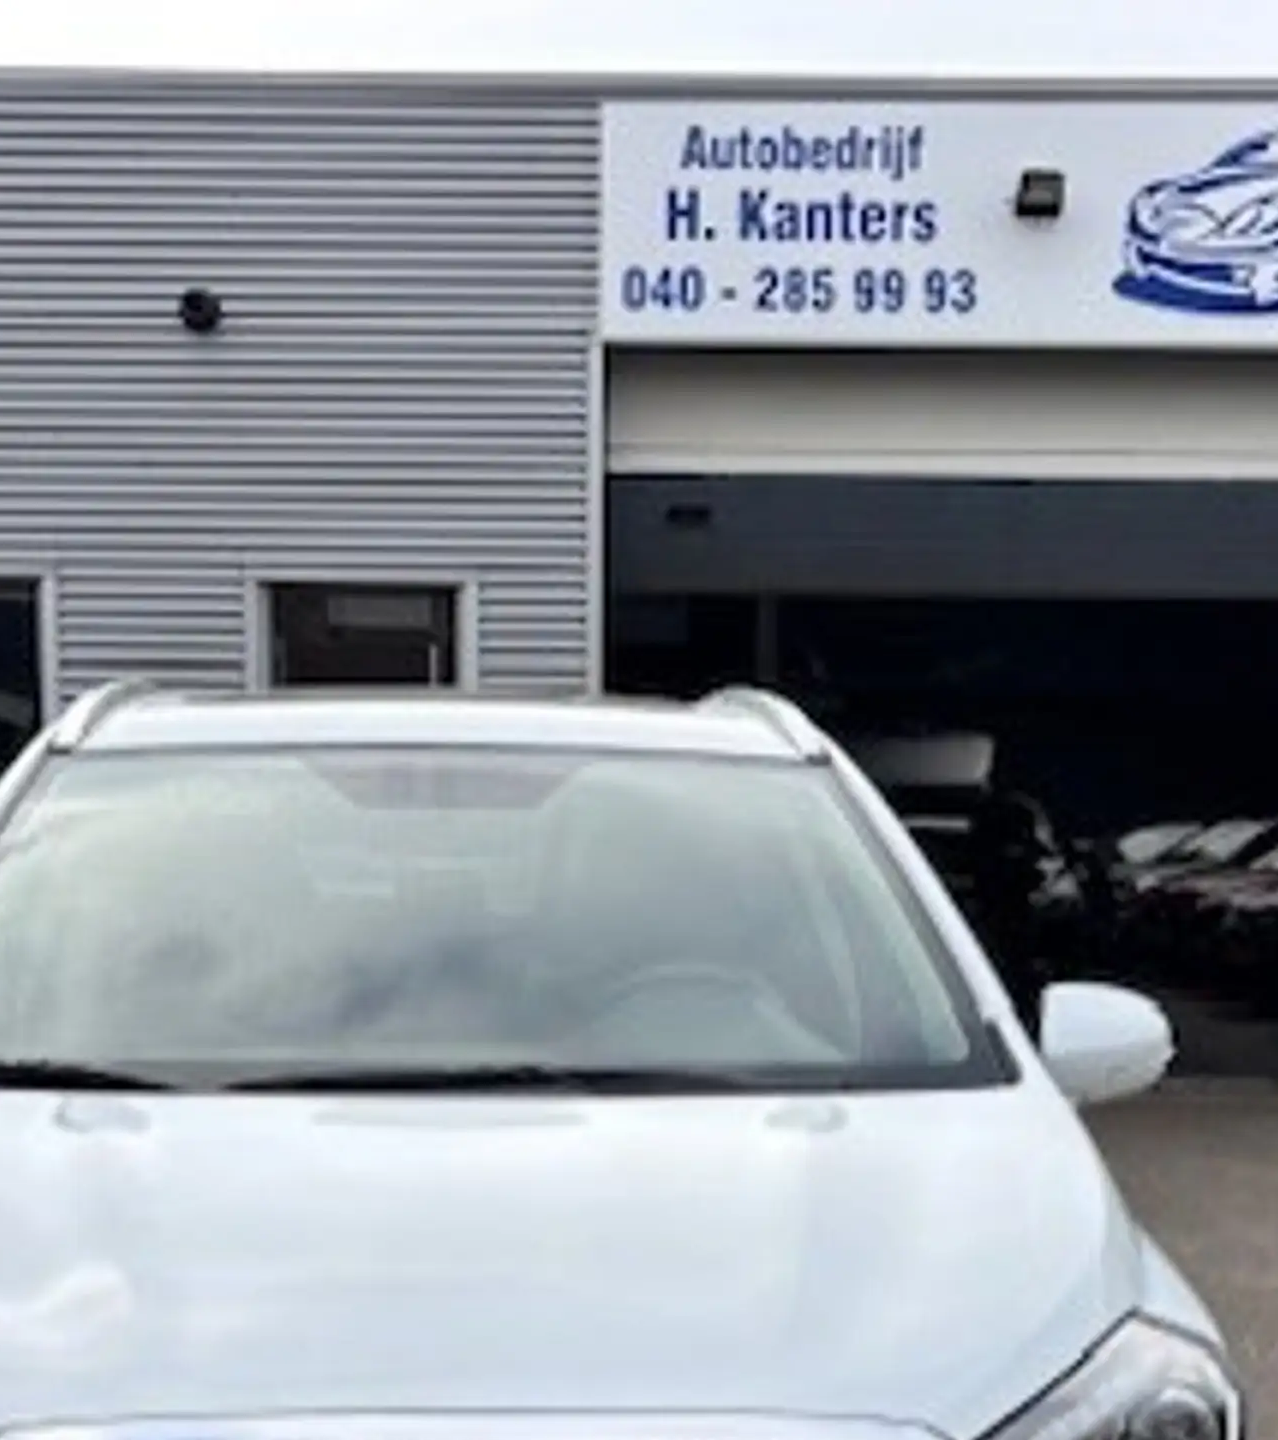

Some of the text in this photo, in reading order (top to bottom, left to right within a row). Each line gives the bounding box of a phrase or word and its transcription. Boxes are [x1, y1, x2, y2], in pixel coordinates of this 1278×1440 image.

[680, 125, 924, 181] Autobedrijf
[666, 188, 939, 242] H. Kanters
[621, 264, 707, 313] 040
[754, 267, 836, 313] 285
[854, 267, 907, 313] 99
[924, 267, 977, 313] 93
